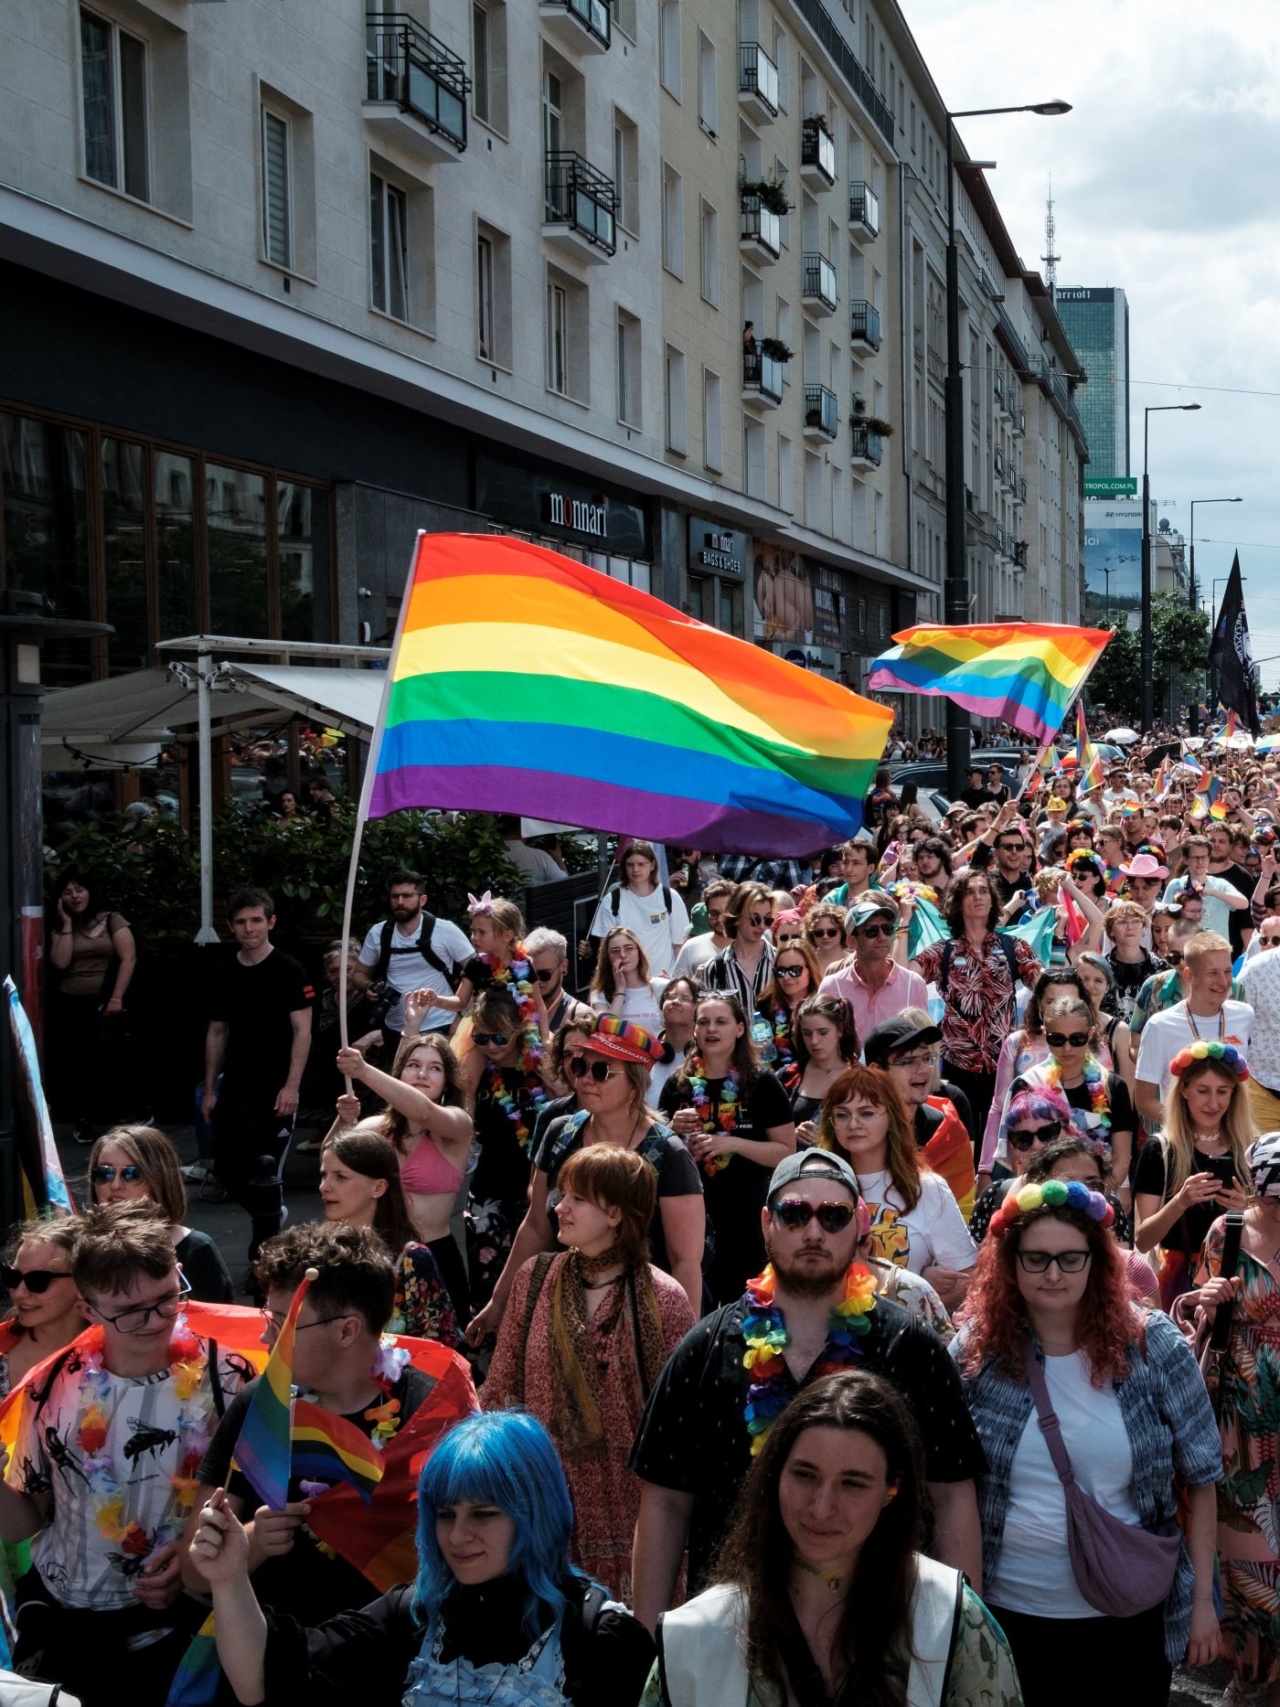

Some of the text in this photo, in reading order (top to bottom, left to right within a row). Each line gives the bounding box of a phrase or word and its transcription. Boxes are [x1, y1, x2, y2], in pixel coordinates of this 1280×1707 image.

[1056, 290, 1091, 299] arriott
[550, 492, 607, 537] monnari
[703, 550, 718, 567] BAGS
[723, 557, 741, 574] SHOES
